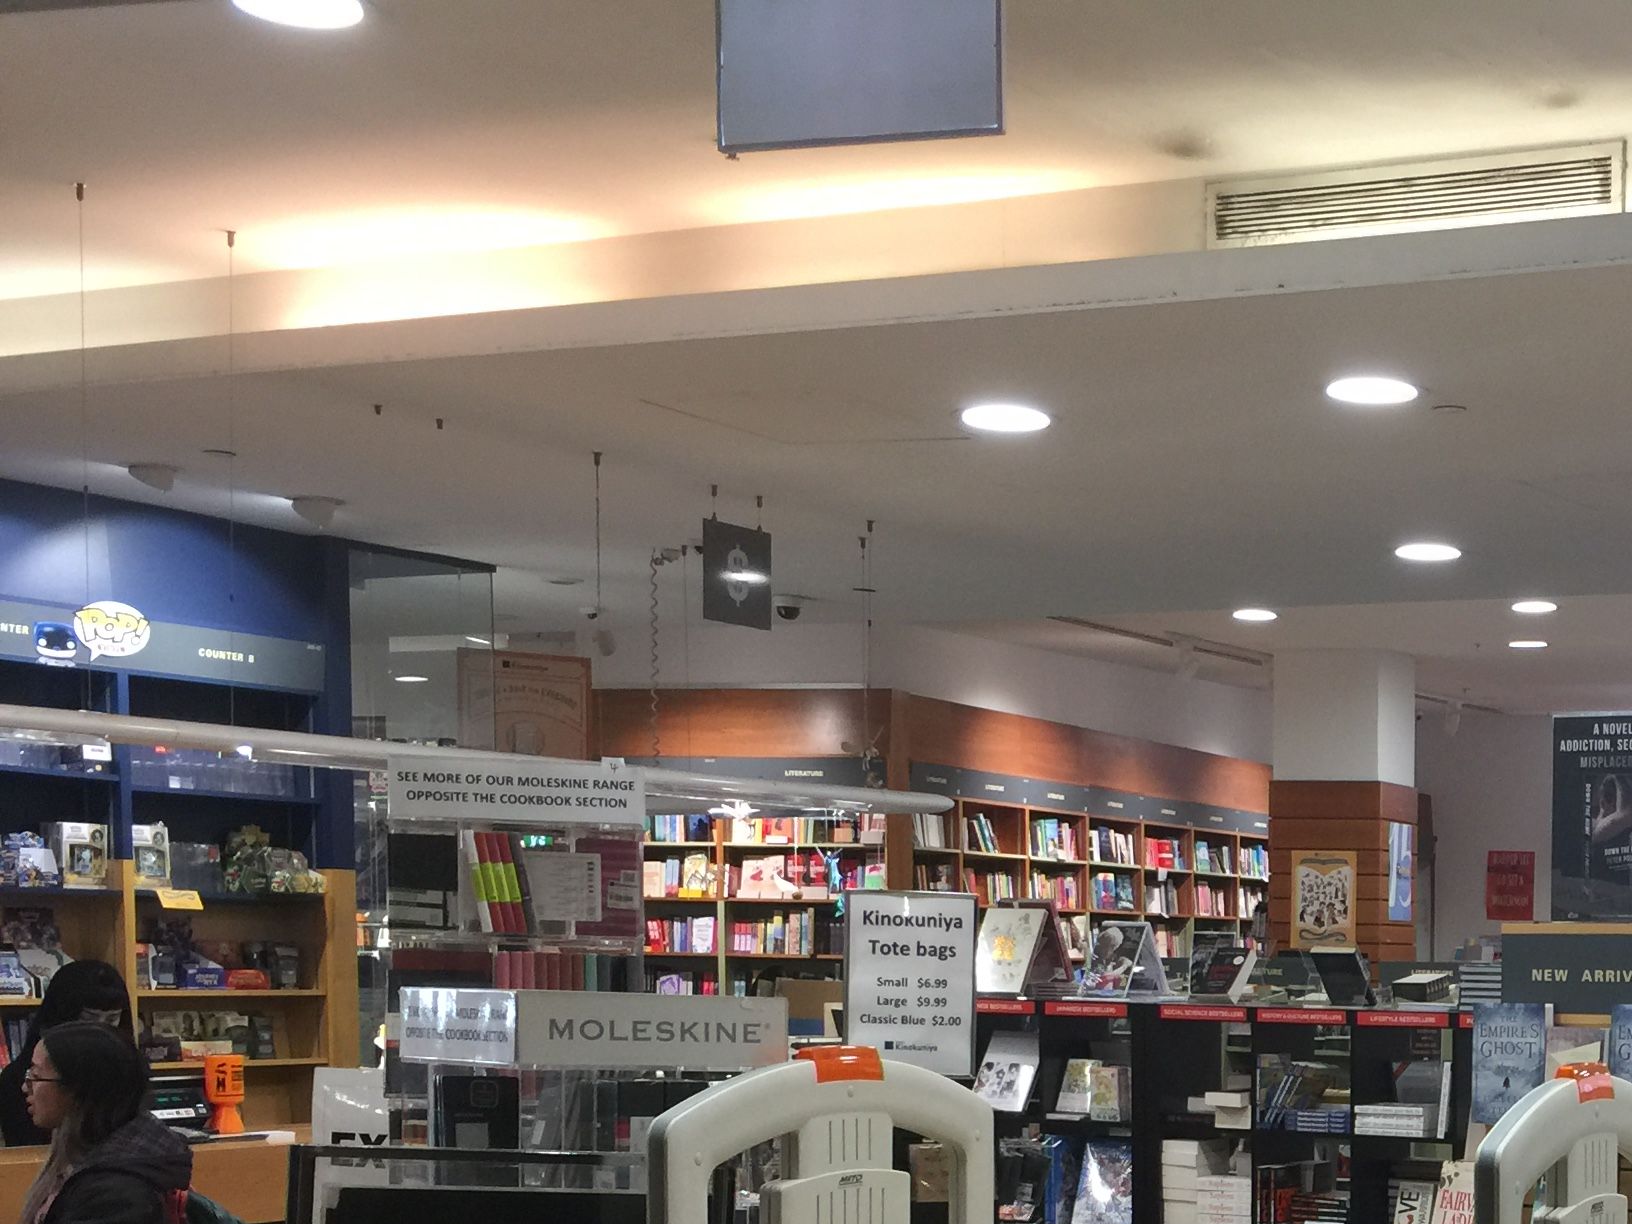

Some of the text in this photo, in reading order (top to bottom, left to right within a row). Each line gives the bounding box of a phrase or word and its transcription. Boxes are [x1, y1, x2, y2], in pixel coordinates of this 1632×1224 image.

[199, 648, 243, 662] COUNTER
[1594, 723, 1599, 735] A
[1603, 723, 1632, 735] NOVEL
[1560, 739, 1614, 752] ADDICTION,
[1580, 756, 1632, 768] MISPLACED
[397, 772, 634, 790] SEE MORE OF OUR MOLESKINE RANGE
[406, 790, 627, 808] OPPOSITE THE COOKBOOK SECTION
[863, 910, 963, 931] Kinokuniya
[869, 940, 956, 961] Tote bags
[1531, 969, 1568, 981] NEW
[877, 977, 948, 989] Small $6.99
[877, 996, 947, 1008] Large $9.99
[860, 1014, 961, 1026] Classic Blue $2.00
[549, 1019, 761, 1043] MOLESKINE
[896, 1044, 937, 1052] Kinokuniya
[1480, 1041, 1537, 1059] GHOST
[1440, 1188, 1475, 1212] FAIRV
